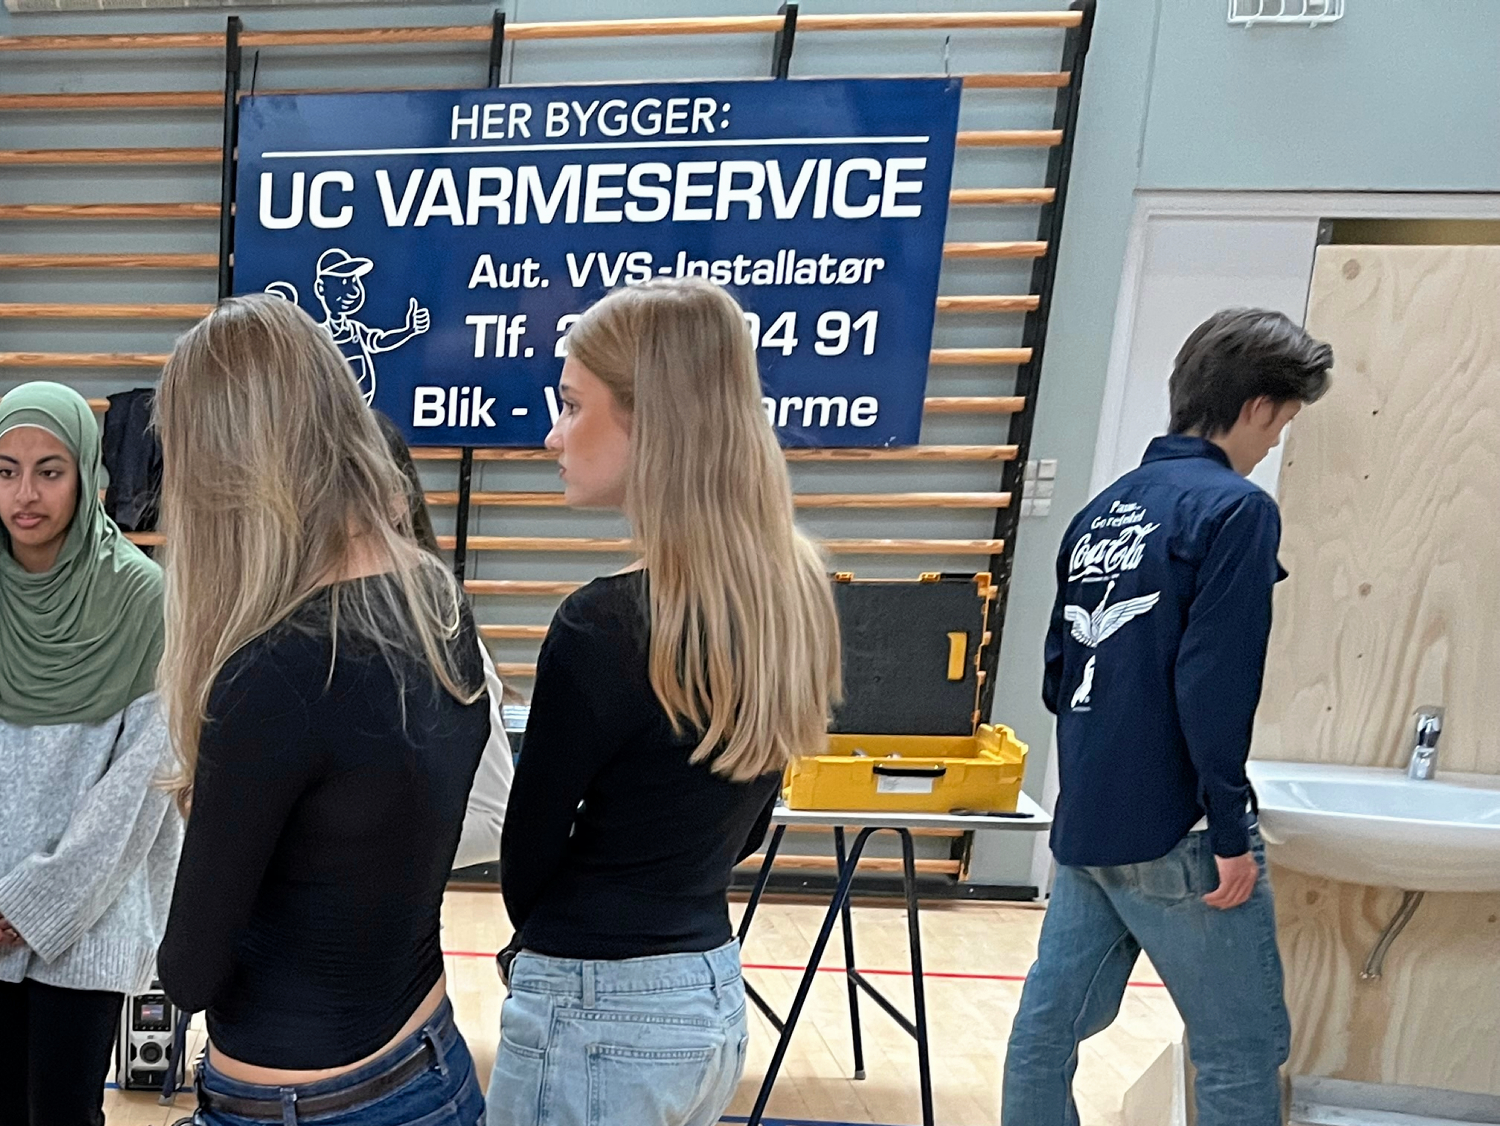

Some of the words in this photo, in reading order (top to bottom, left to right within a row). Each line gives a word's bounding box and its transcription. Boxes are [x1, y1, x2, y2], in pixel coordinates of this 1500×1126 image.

[450, 102, 531, 141] HER
[545, 97, 732, 139] BYGGER:
[258, 171, 355, 230] UC
[375, 157, 928, 227] VARMESERVICE
[467, 253, 550, 289] Aut.
[565, 249, 885, 288] VVS-Installatør
[465, 313, 535, 358] Tlf.
[814, 310, 879, 357] 91
[412, 385, 497, 427] Blik
[760, 396, 879, 427] arme
